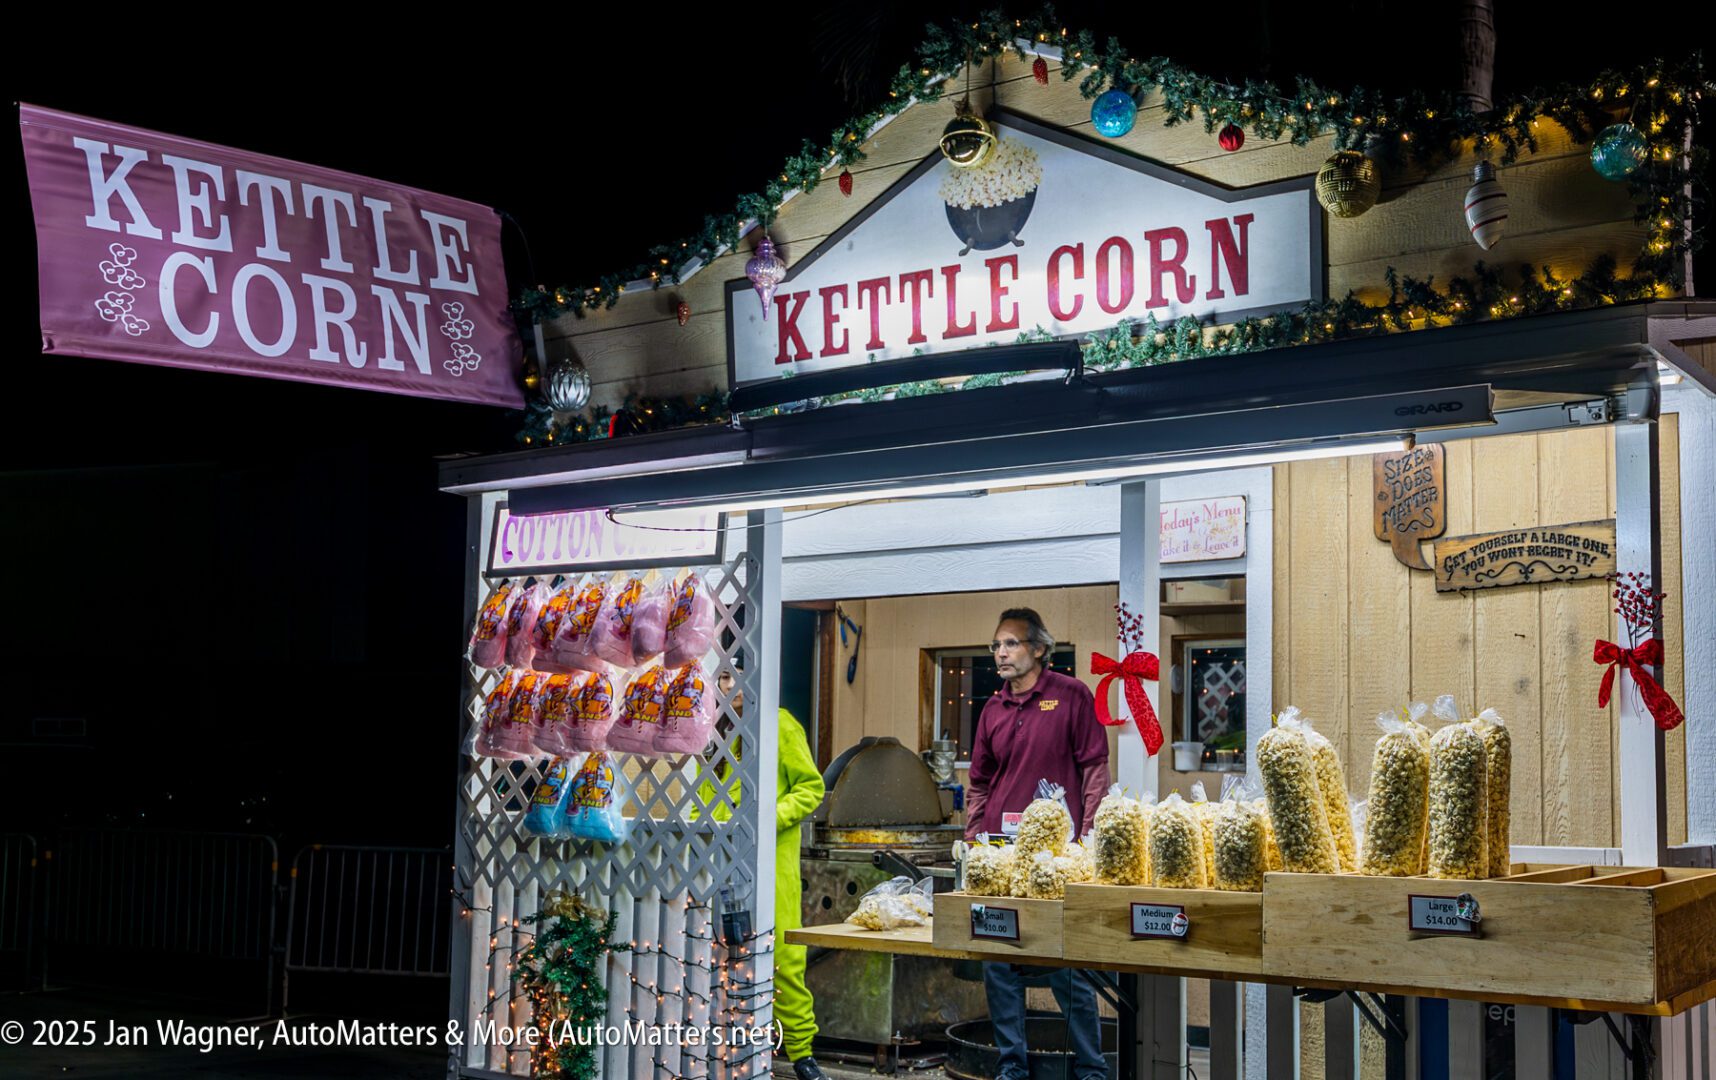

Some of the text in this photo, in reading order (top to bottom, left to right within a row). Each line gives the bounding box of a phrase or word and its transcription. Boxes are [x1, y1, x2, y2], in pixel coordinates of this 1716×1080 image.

[73, 136, 479, 296] KETTLE
[774, 213, 1255, 366] KETTLE CORN
[158, 251, 433, 376] CORN
[1394, 401, 1464, 416] GIRARD
[1384, 449, 1425, 480] SIZE
[1391, 466, 1433, 501] DOES
[1202, 501, 1242, 523] Menu
[1382, 486, 1438, 533] MATTER
[501, 509, 605, 564] COTTON
[1444, 532, 1612, 581] GET YOURSELF A LARGE ONE,
[1461, 556, 1485, 576] YOU
[1527, 545, 1573, 560] REGRET
[1576, 551, 1598, 567] IT!
[985, 911, 1004, 920] Small
[1140, 908, 1174, 918] Medium
[1425, 914, 1458, 926] $14.00
[1428, 901, 1454, 913] Large
[983, 923, 1007, 933] $10.00
[1144, 921, 1171, 931] $12.00
